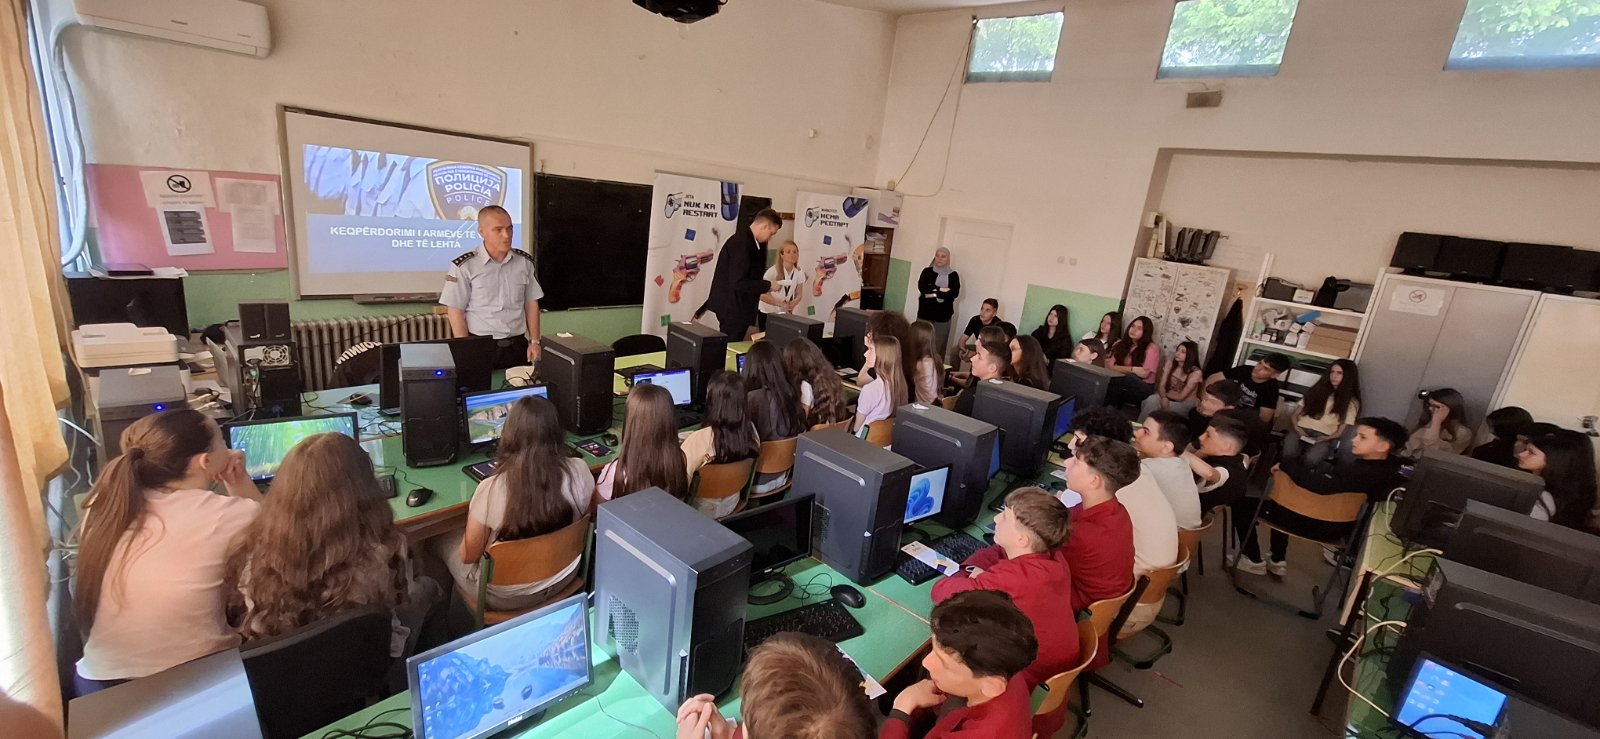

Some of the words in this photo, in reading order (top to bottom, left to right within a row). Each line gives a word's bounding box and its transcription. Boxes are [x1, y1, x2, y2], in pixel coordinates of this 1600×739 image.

[435, 173, 501, 193] ПОЛИЦИЈА
[444, 182, 492, 197] POLICIA
[446, 194, 490, 206] POLICE
[703, 202, 716, 210] KA
[682, 209, 718, 218] RESTART
[330, 226, 415, 237] KEQPËRDORIMI
[418, 229, 421, 237] I
[423, 229, 462, 238] ARMËVE
[391, 239, 414, 248] DHE
[416, 239, 428, 248] TË
[430, 240, 461, 248] LEHTA
